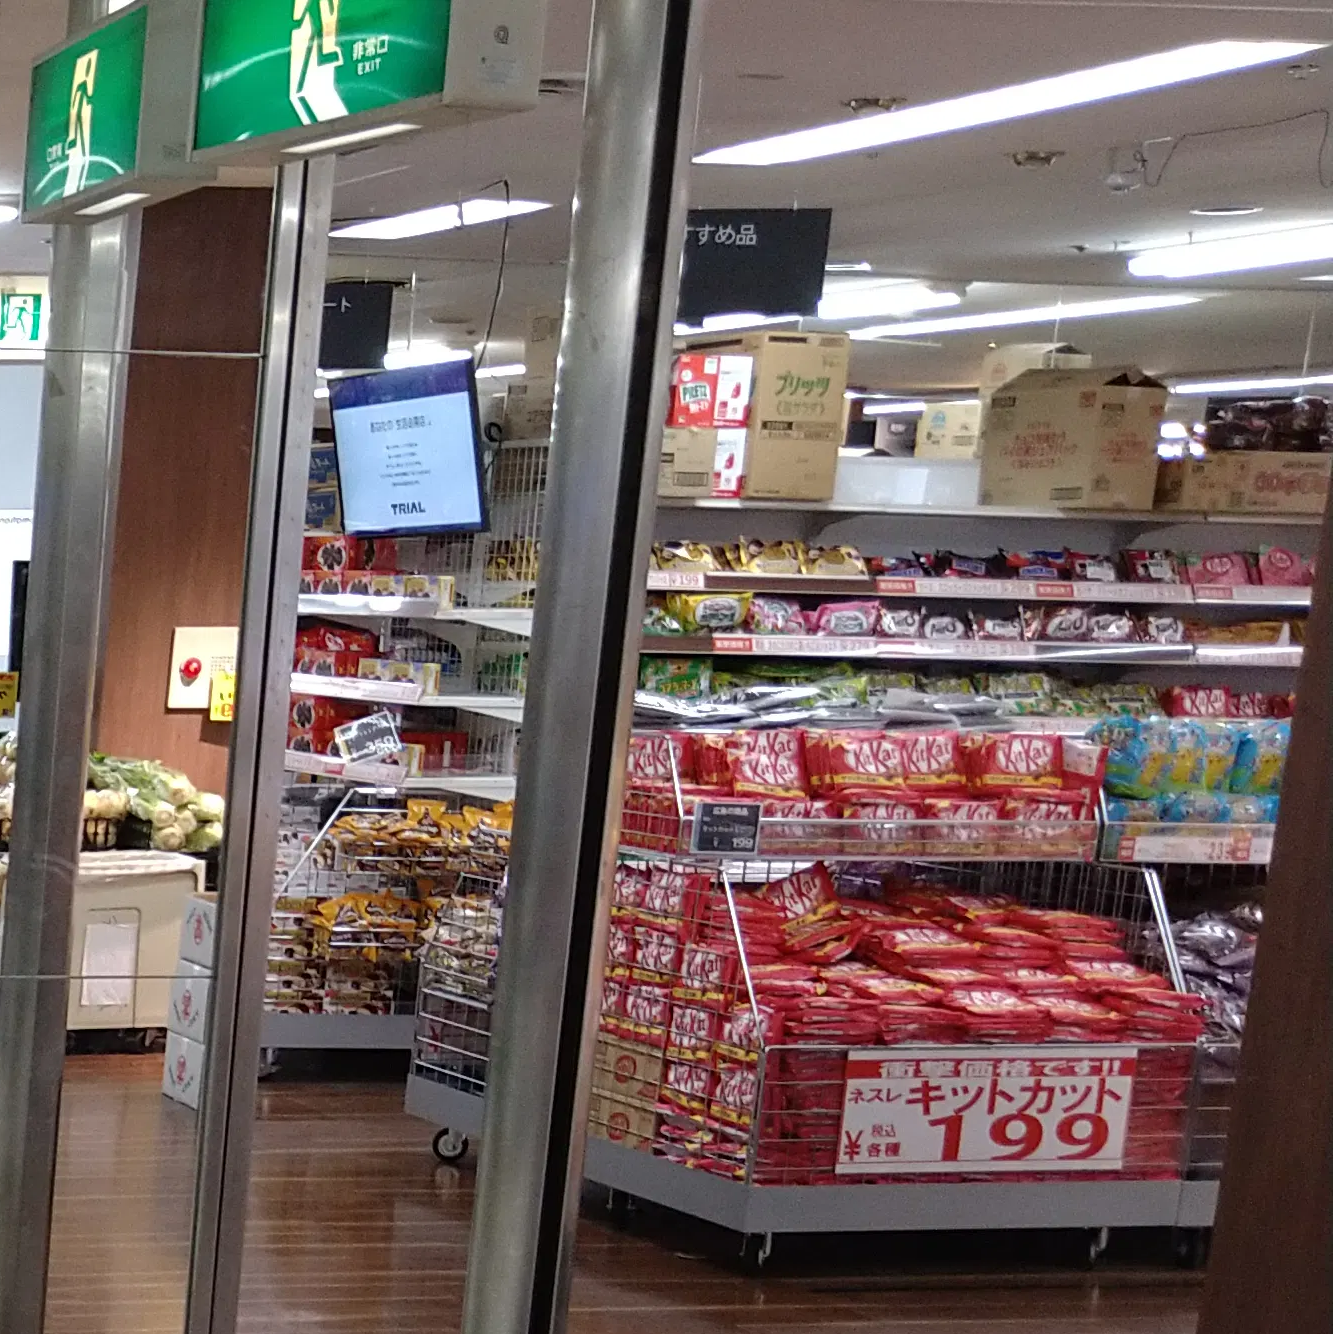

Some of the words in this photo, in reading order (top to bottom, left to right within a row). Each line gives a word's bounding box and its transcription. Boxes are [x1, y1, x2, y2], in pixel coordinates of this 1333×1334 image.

[353, 35, 389, 61] 非常口
[357, 59, 381, 76] EXIT
[681, 385, 708, 403] PRETZ
[775, 370, 831, 397] プリッツ
[390, 501, 426, 515] TRIAL
[904, 735, 952, 773] KitKat
[1002, 737, 1052, 773] KitKat
[732, 836, 754, 848] 199
[848, 1087, 902, 1105] ネスレ
[906, 1077, 1123, 1116] キットカット
[867, 1142, 902, 1158] 各種
[928, 1112, 1110, 1162] 199
